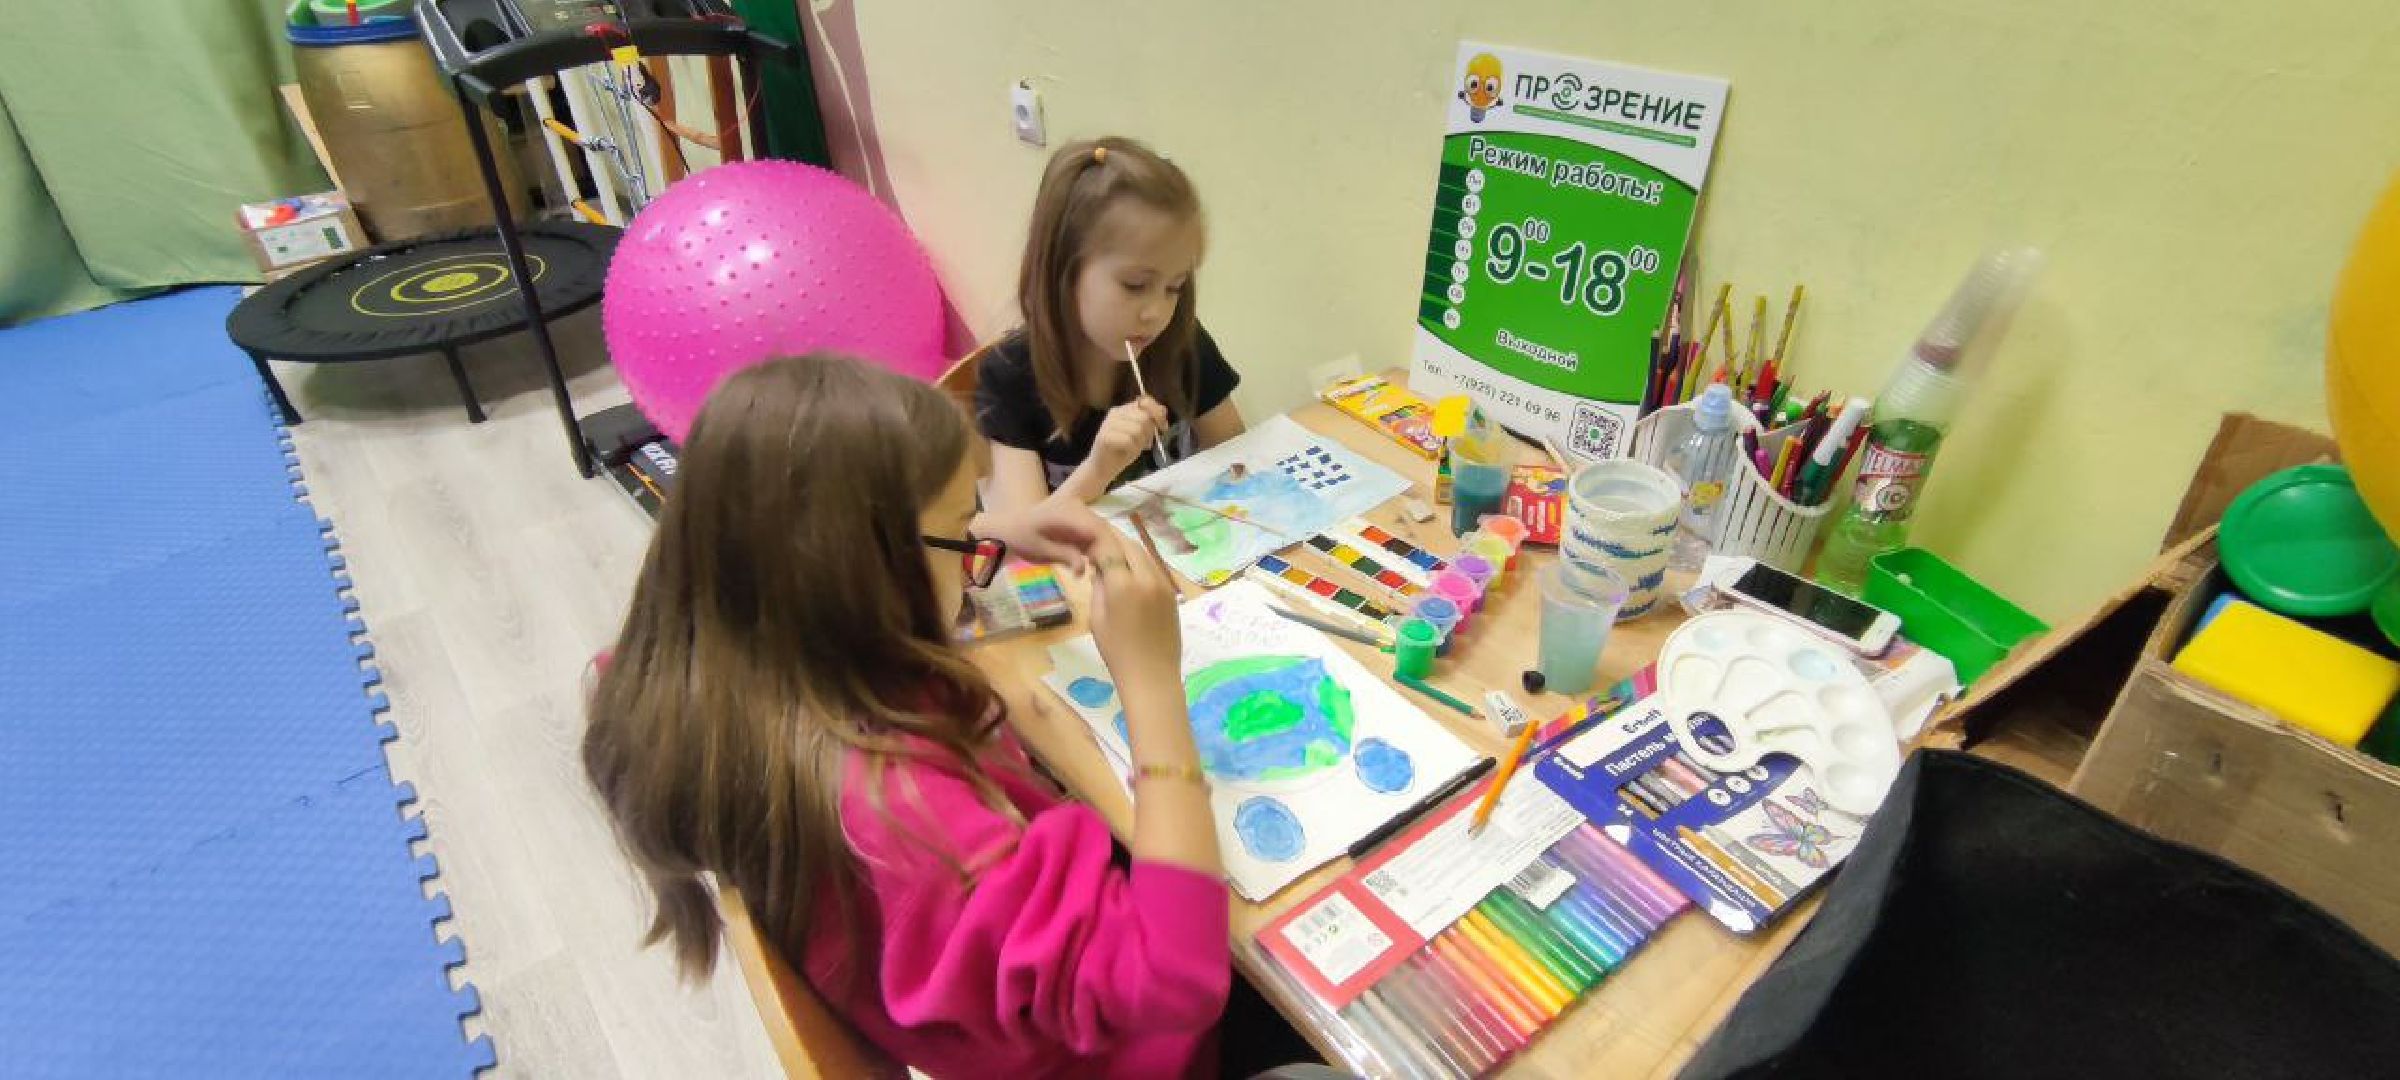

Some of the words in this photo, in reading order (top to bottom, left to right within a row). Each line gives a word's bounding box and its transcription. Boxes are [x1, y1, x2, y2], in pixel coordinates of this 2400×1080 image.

[1470, 136, 1547, 178] Режим
[1550, 162, 1663, 205] работы:
[1497, 329, 1577, 370] Выходной
[1605, 741, 1667, 776] Пастель
